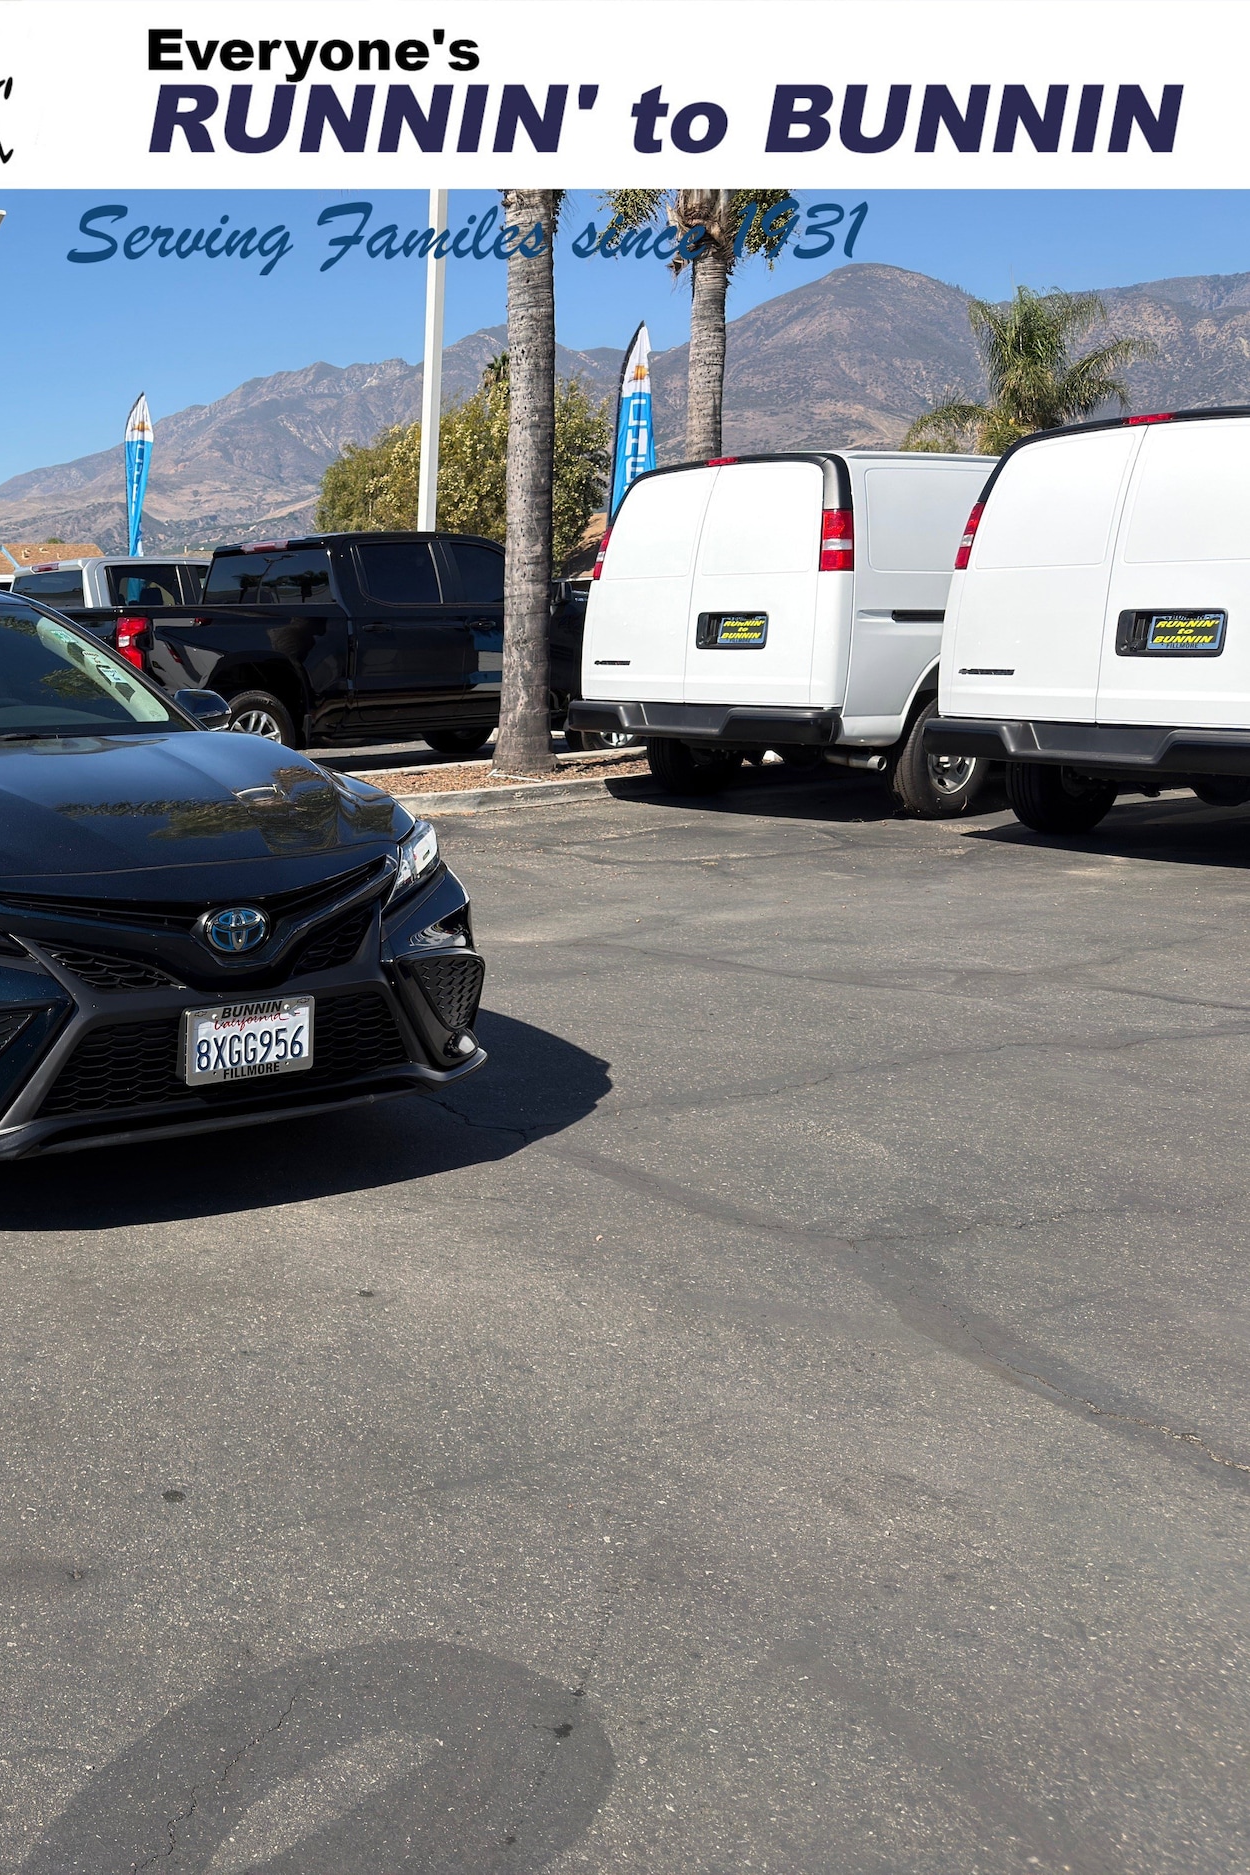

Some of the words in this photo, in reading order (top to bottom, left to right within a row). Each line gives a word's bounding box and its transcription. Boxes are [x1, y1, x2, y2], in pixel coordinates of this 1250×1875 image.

[1152, 635, 1214, 644] BUNNIN
[221, 1000, 283, 1019] BUNNIN
[196, 1025, 305, 1071] 8XGG956
[223, 1061, 280, 1079] FILLMORE
